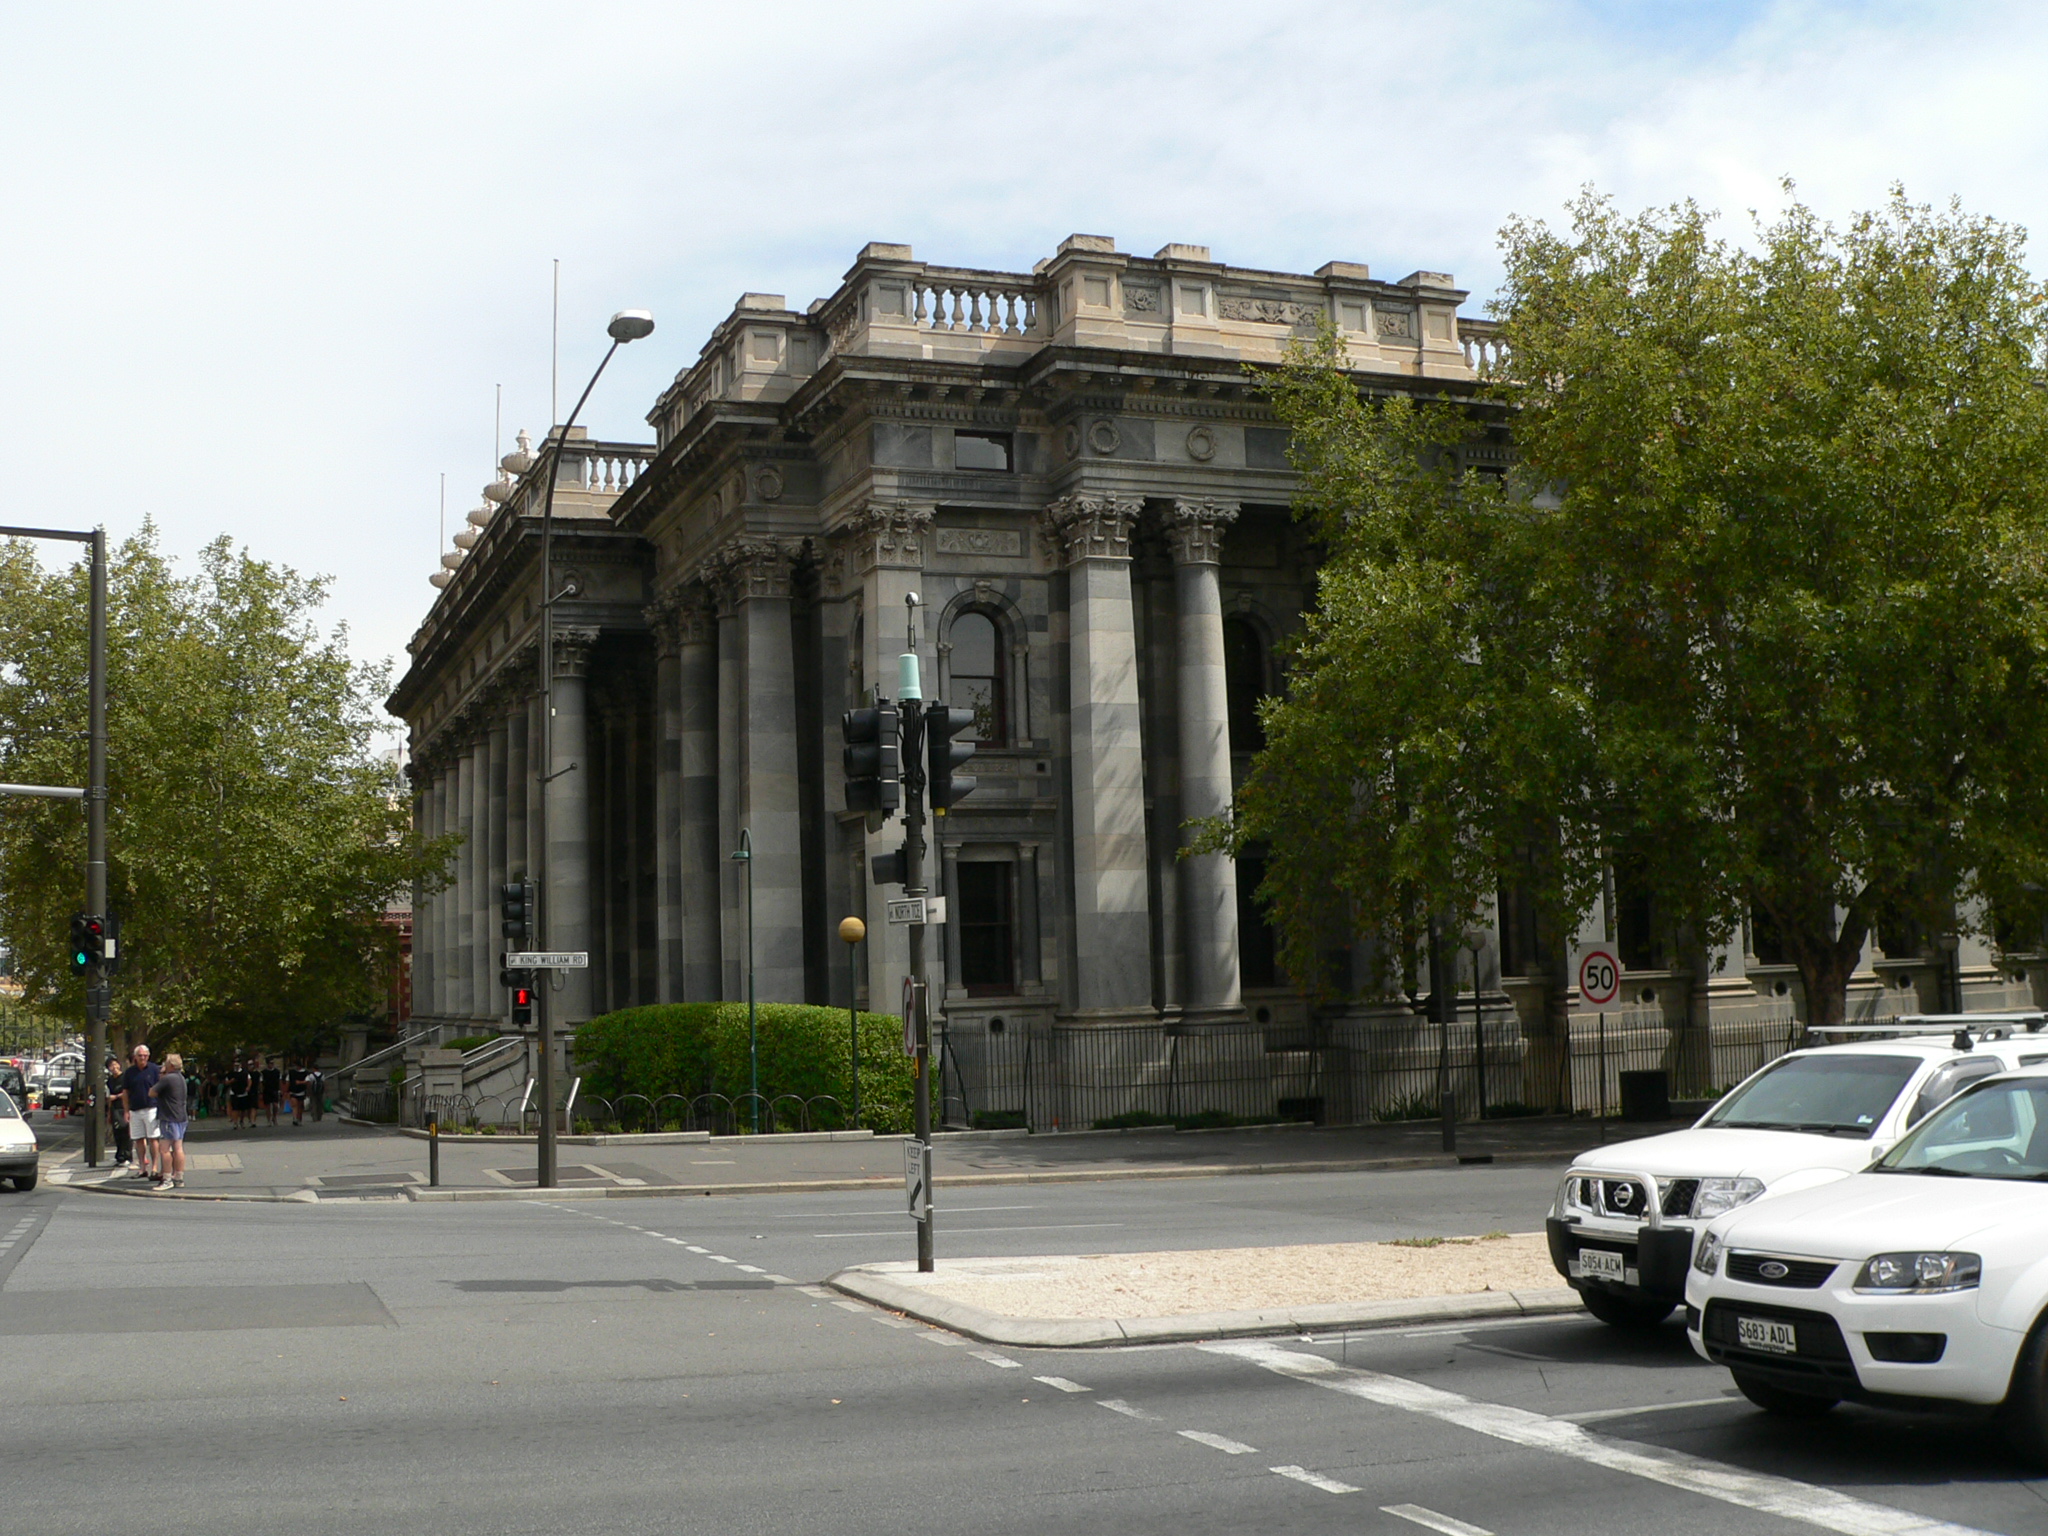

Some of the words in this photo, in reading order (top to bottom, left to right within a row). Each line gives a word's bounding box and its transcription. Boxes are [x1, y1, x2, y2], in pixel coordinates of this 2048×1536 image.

[520, 956, 537, 965] KING
[540, 956, 570, 965] WILLIAM
[573, 956, 583, 965] RD
[1587, 965, 1613, 990] 50
[907, 1146, 920, 1159] KEEP
[907, 1162, 920, 1176] LEFT
